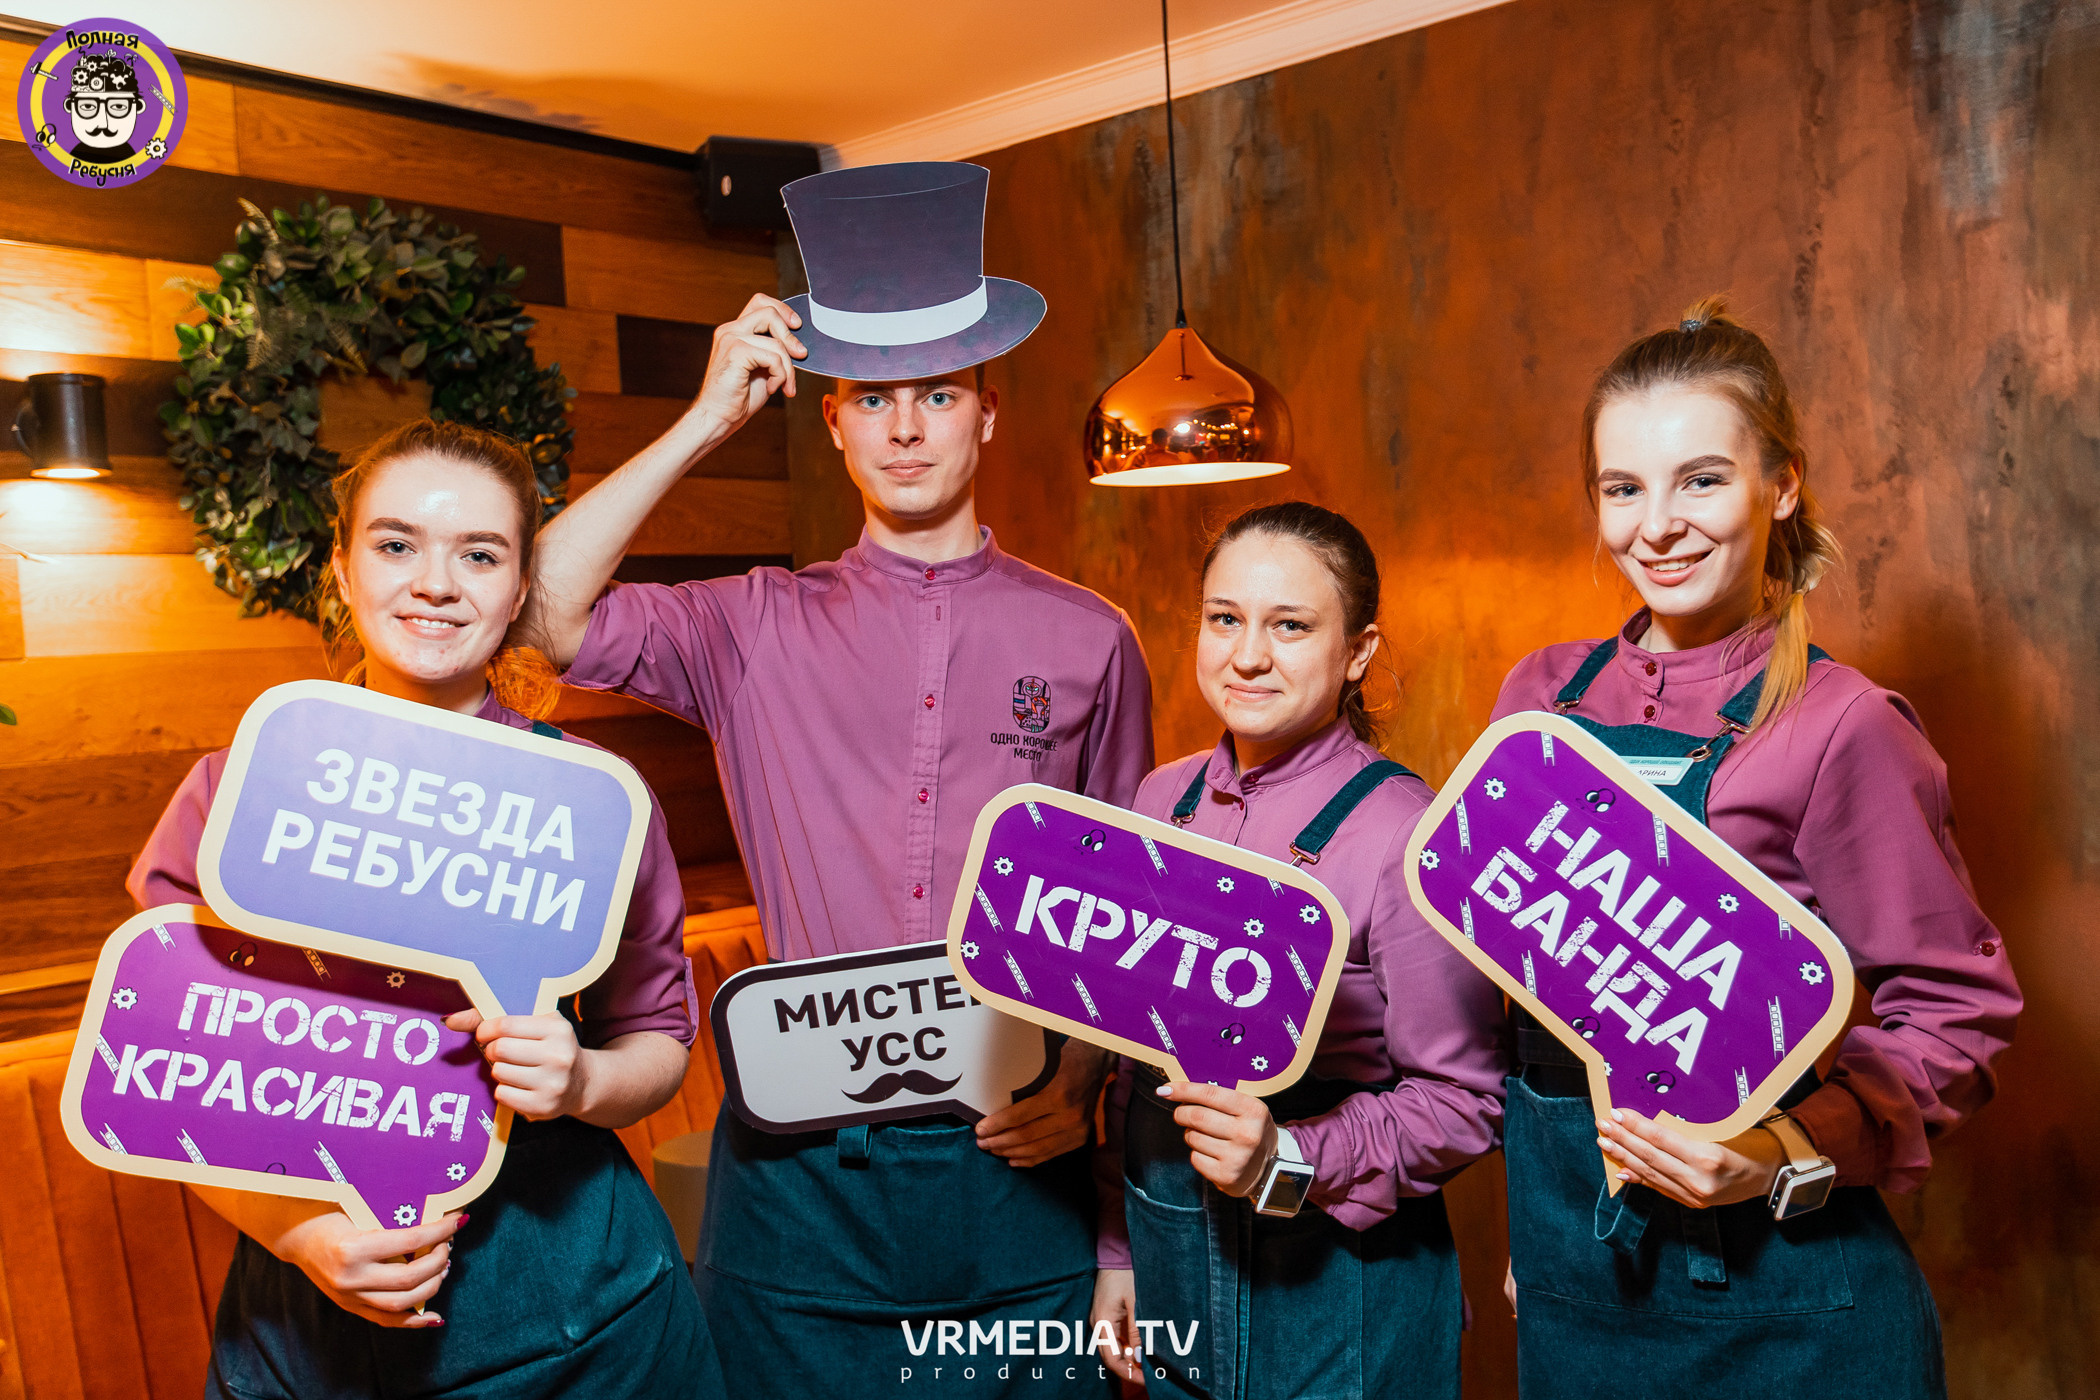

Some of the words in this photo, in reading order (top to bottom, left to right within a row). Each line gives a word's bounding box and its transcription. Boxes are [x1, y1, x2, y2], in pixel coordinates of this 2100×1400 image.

[991, 733, 1020, 745] ОДНО
[1014, 748, 1042, 761] МЕСТО
[306, 748, 576, 862] ЗВЕЗДА
[261, 808, 586, 932] РЕБУСНИ
[1525, 800, 1743, 1011] НАША
[1014, 875, 1272, 1008] КРУТО
[1471, 846, 1709, 1075] БАНДА
[176, 982, 440, 1066] ПРОСТО
[773, 974, 982, 1033] МИСТЕ
[841, 1027, 947, 1072] УСС
[112, 1044, 471, 1142] КРАСИВАЯ
